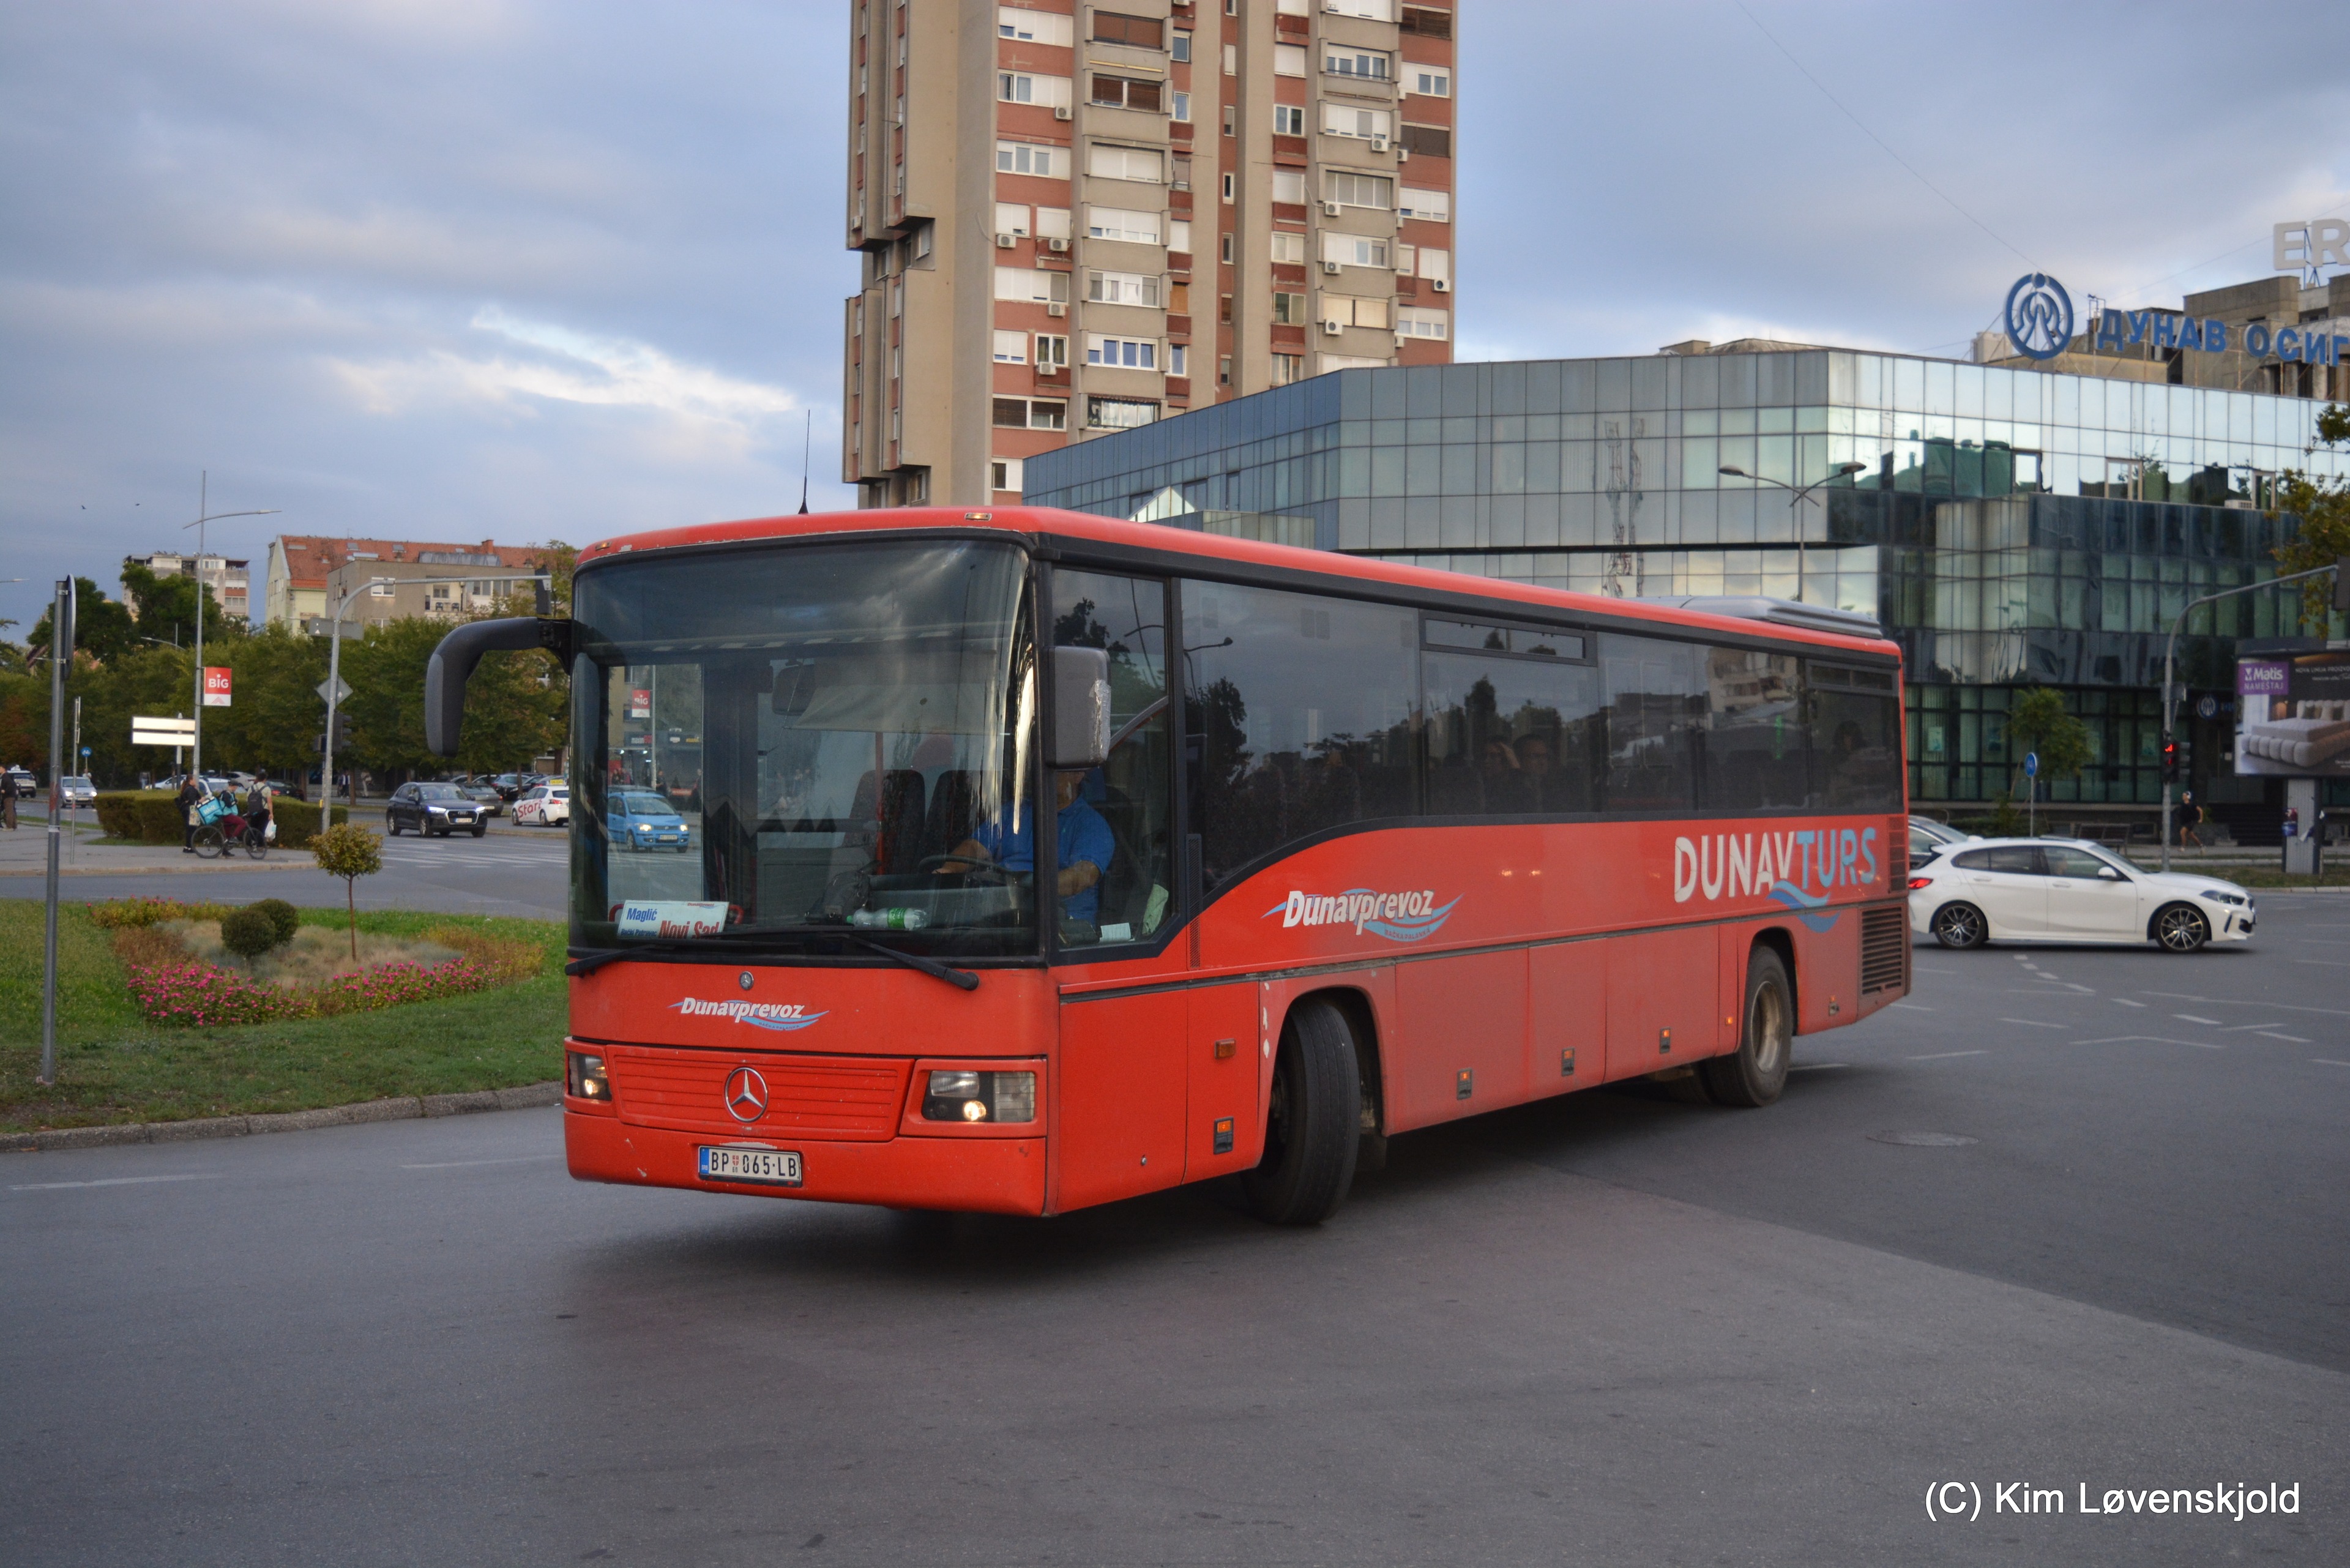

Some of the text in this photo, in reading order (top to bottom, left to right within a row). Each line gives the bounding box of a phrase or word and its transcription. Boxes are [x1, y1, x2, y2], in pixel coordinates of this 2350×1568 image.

[2095, 307, 2227, 353] ДУНАВ
[2253, 667, 2283, 681] Matis
[2244, 681, 2284, 690] NAMEŠTAJ
[1674, 827, 1877, 903] DUNAVTURS
[626, 908, 657, 922] Maglić
[1282, 890, 1434, 936] Dunavprevoz
[658, 920, 690, 939] Novi
[681, 997, 805, 1023] Dunavprevoz
